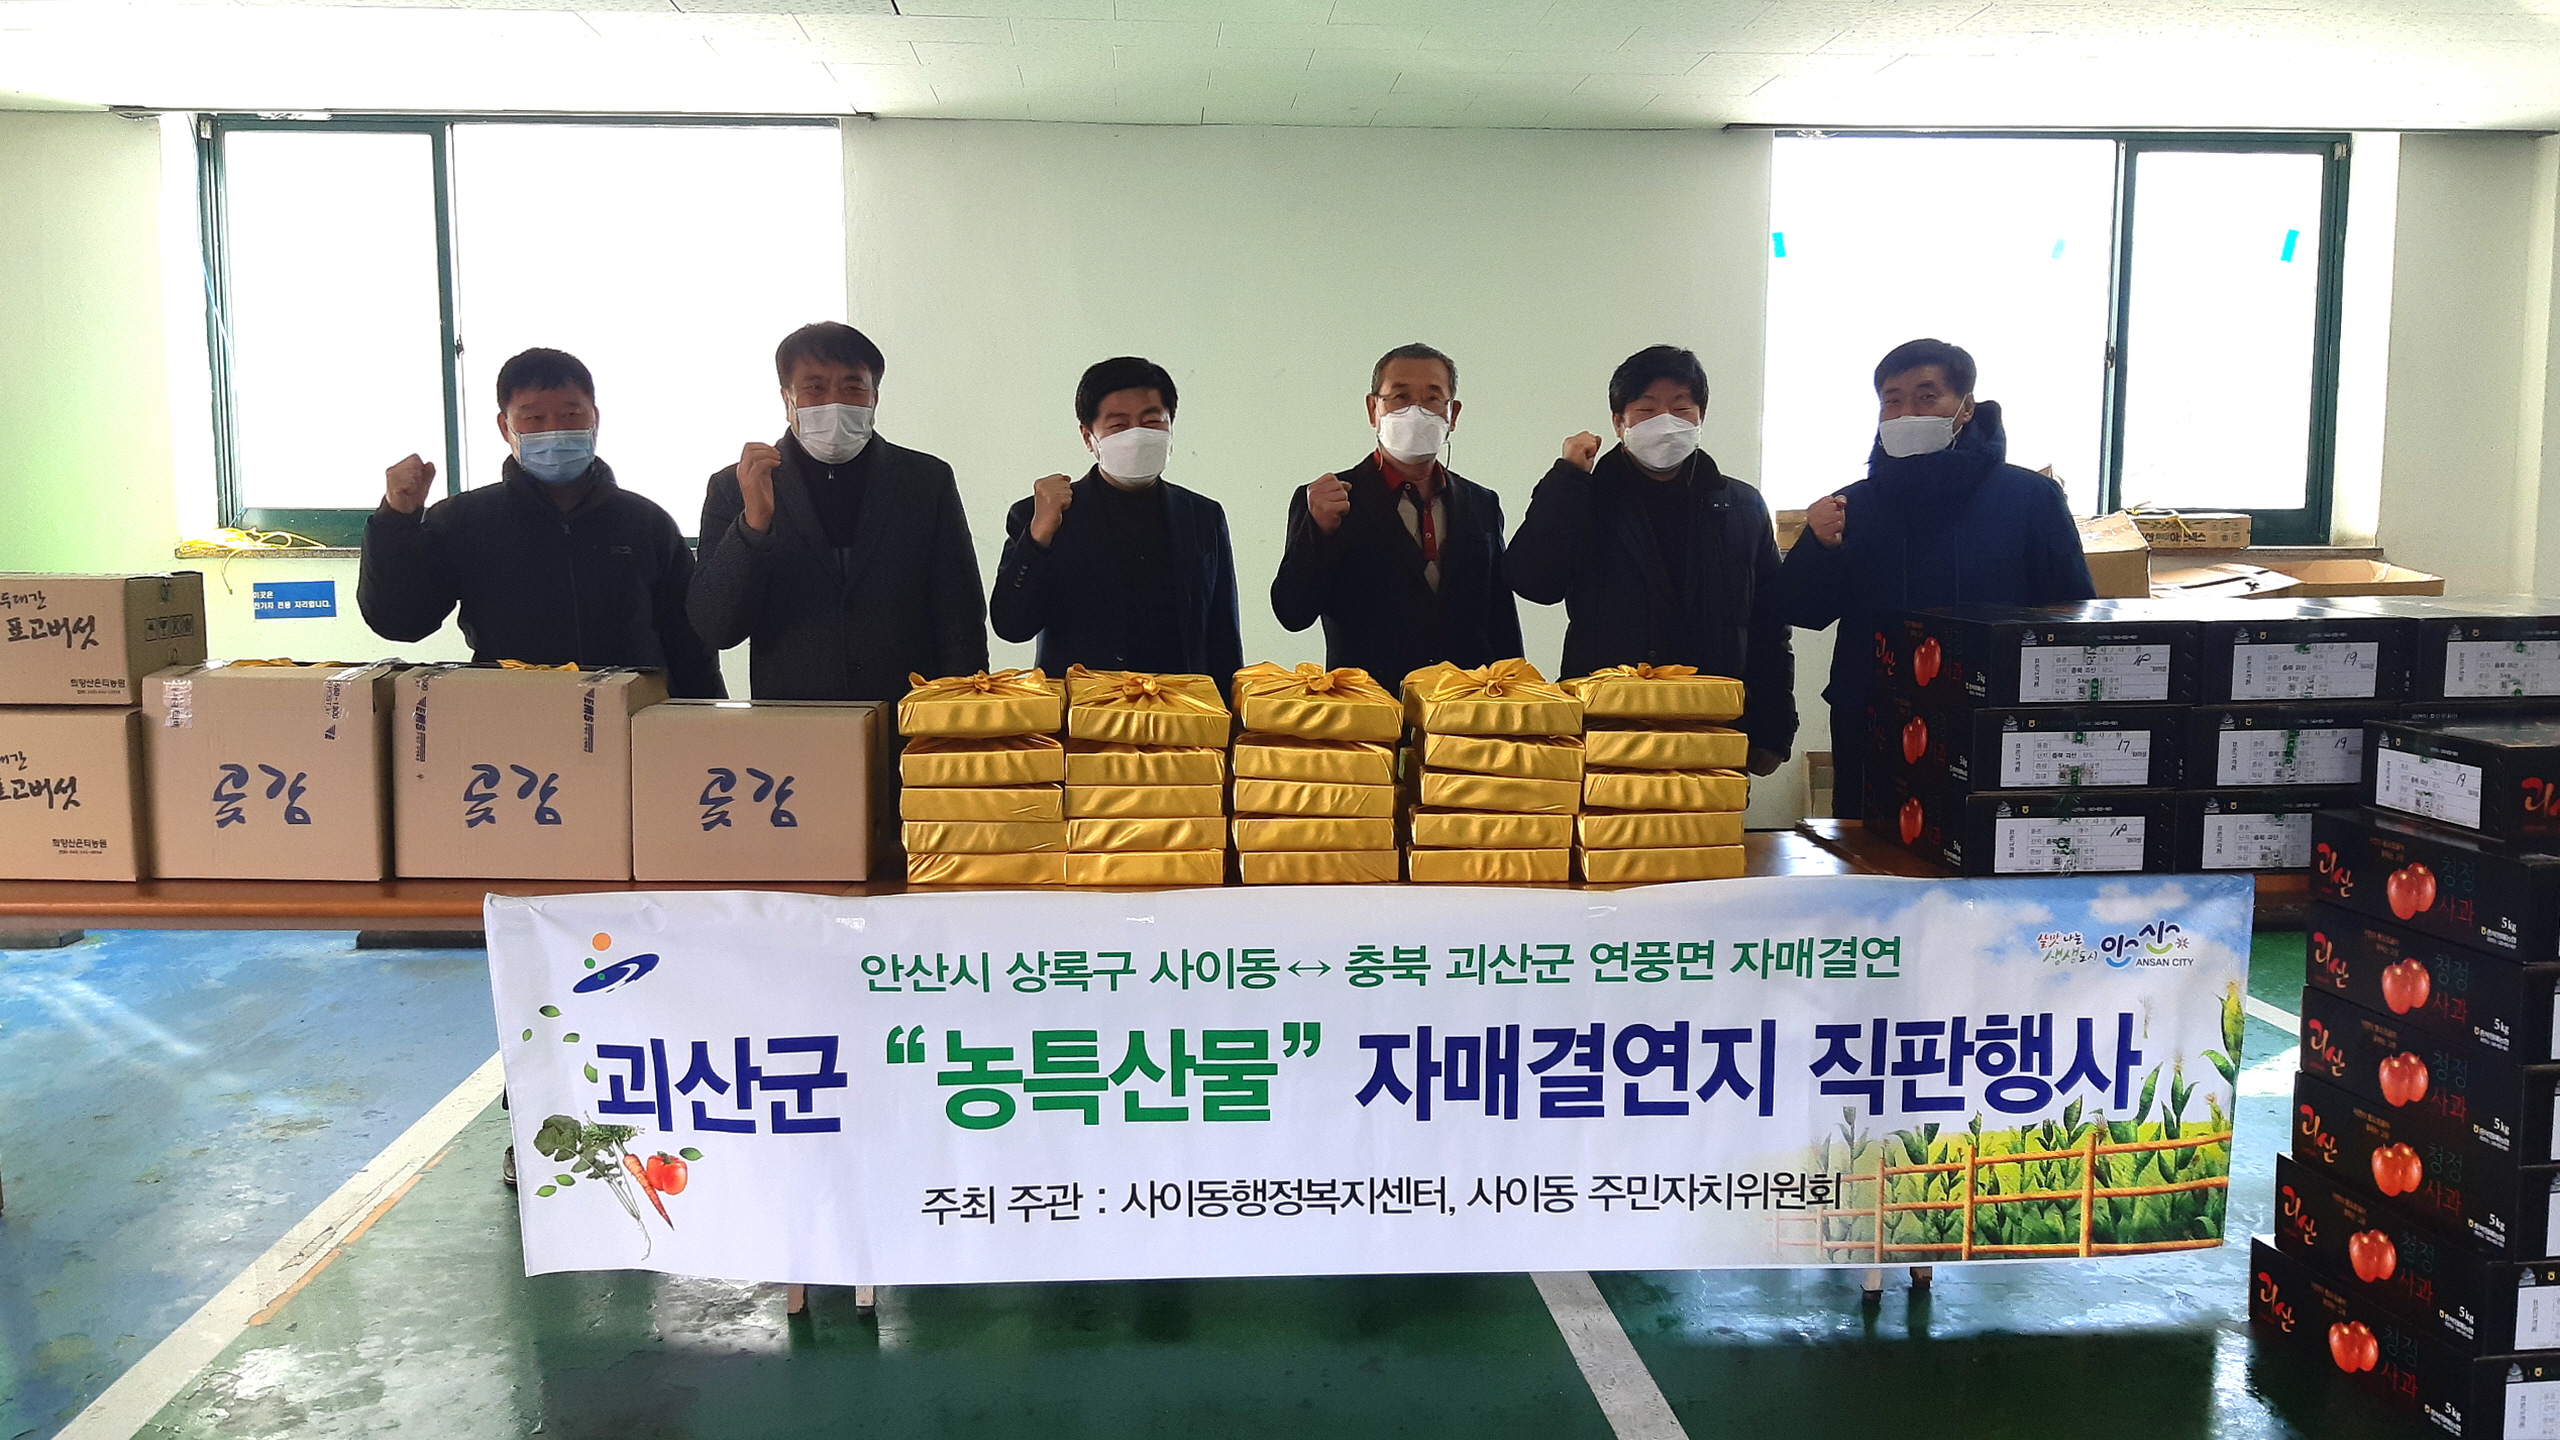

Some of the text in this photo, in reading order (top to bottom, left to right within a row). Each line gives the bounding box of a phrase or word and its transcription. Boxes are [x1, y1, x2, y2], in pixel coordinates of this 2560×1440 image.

[6, 615, 99, 650] 표고버섯
[2344, 651, 2358, 666] 19
[416, 706, 426, 732] EMS
[584, 696, 595, 723] EMS
[2117, 739, 2131, 753] 17
[2334, 736, 2348, 749] 19
[212, 763, 312, 829] 곶감
[463, 763, 563, 829] 곶감
[699, 767, 798, 832] 곶감
[2501, 917, 2517, 934] 5kg
[2101, 921, 2180, 968] 안산
[862, 937, 1900, 992] 안산시 상록구 사이동 충북 괴산군 연풍면 자매결연
[2135, 958, 2194, 967] ANSAN CITY
[2494, 1018, 2510, 1036] 5kg
[598, 1036, 847, 1133] 괴산군
[1356, 1020, 1775, 1121] 자매결연지
[1810, 1013, 2141, 1114] 직판행사
[2494, 1118, 2510, 1136] 5kg
[922, 1187, 994, 1225] 주최
[1008, 1183, 1083, 1222] 주관
[1122, 1177, 1455, 1218] 사이동행정복지센터,
[1468, 1176, 1577, 1212] 사이동
[1589, 1173, 1841, 1211] 주민자치위원회
[2489, 1213, 2505, 1233] 5kg
[2458, 1305, 2475, 1324] 5kg
[2445, 1402, 2462, 1422] 5kg
